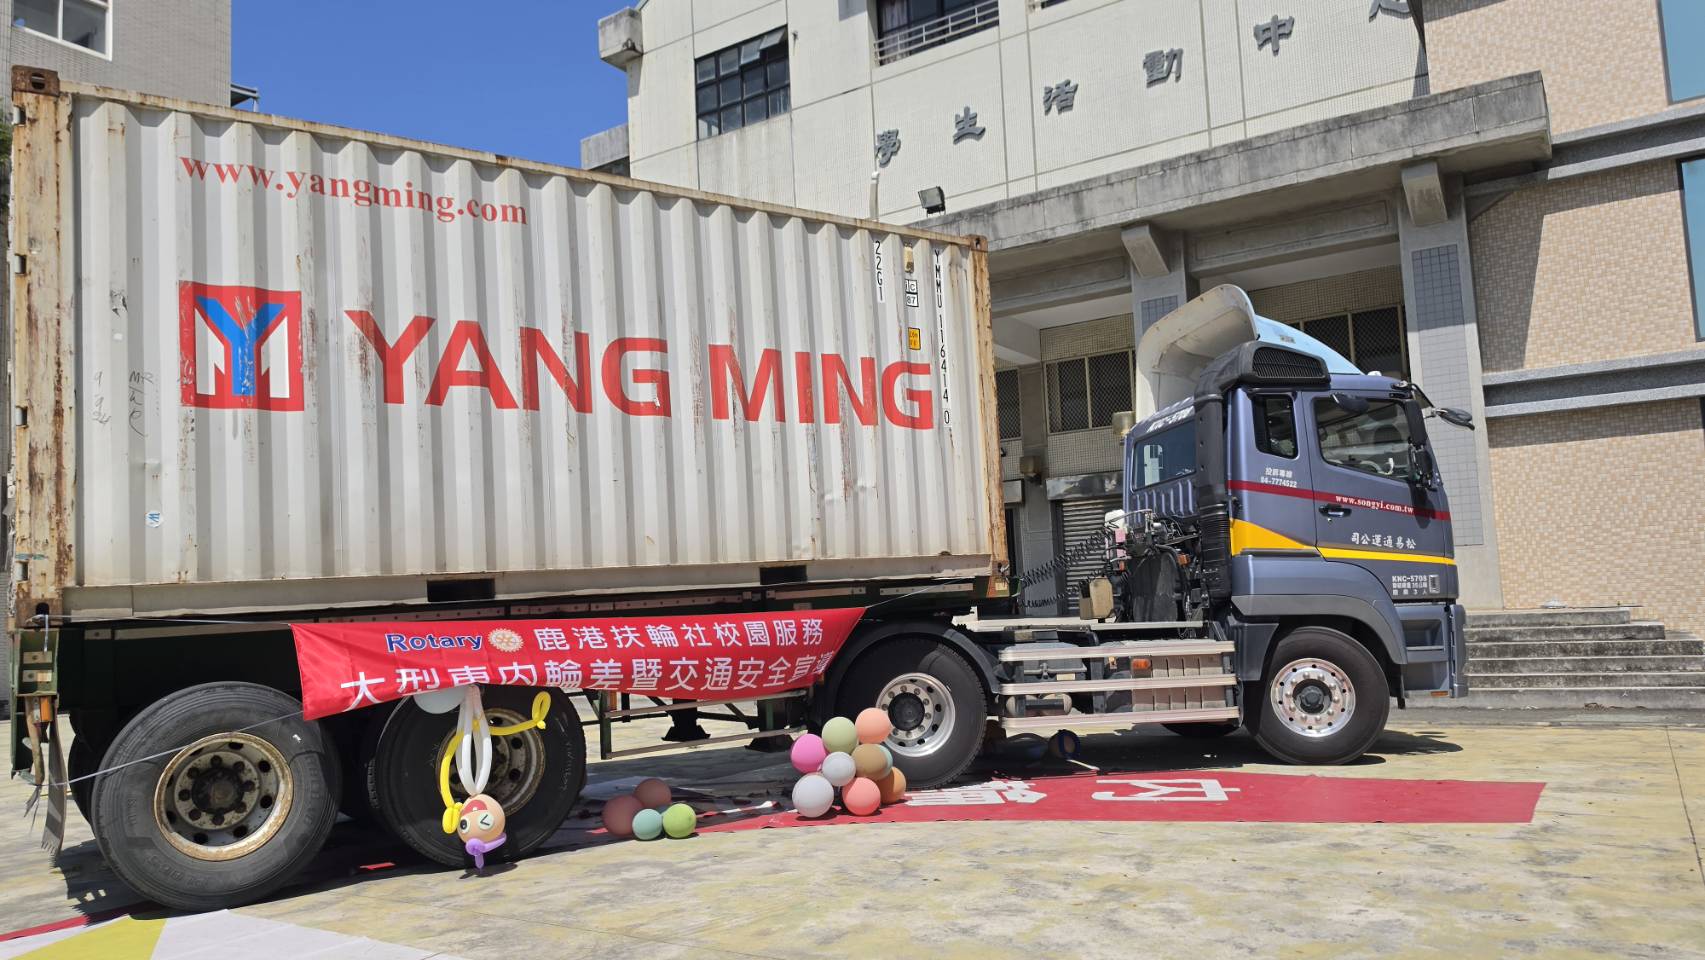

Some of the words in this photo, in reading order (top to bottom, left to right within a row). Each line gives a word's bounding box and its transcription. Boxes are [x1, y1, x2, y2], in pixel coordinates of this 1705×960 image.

[875, 0, 1412, 168] 學生活動中
[179, 156, 528, 225] www.yangming.com
[344, 309, 672, 418] YANG
[708, 343, 935, 430] MING
[1335, 495, 1414, 514] www.songyi.com.tw
[384, 633, 483, 653] Rotary
[533, 618, 824, 651] 鹿港扶輪社校園服務
